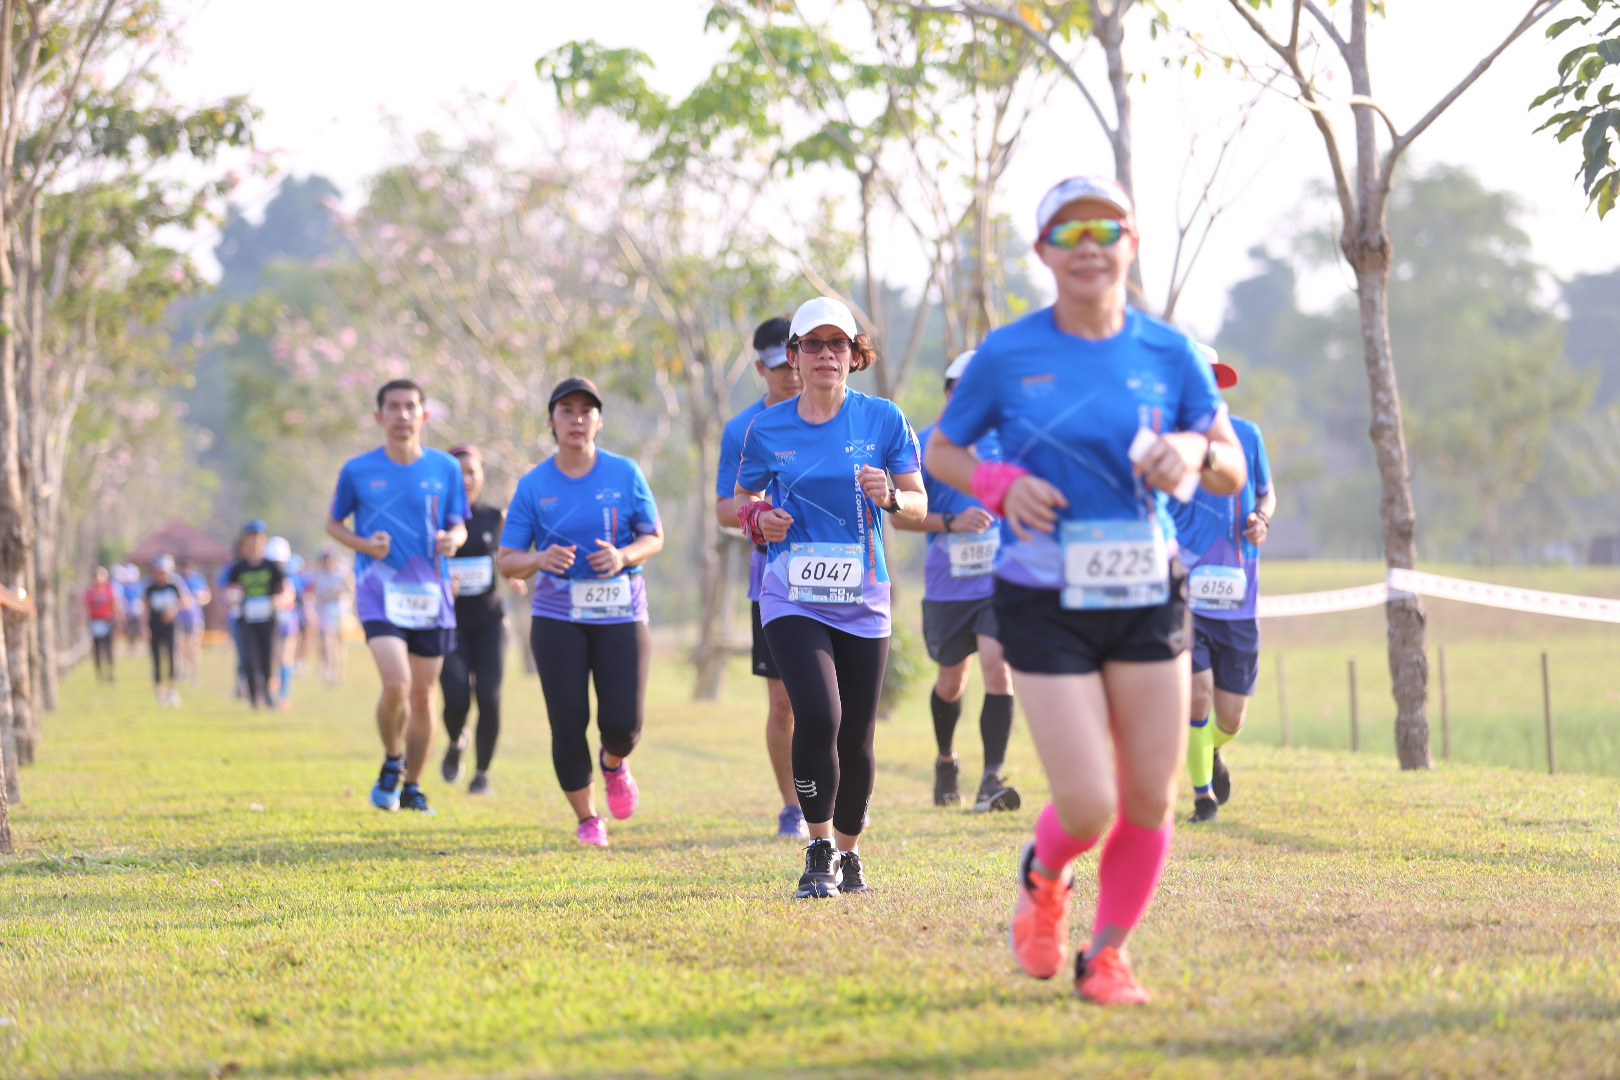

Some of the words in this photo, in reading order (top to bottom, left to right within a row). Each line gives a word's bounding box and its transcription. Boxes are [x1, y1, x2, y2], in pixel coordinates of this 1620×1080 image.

[855, 493, 865, 535] COUNTRY
[867, 528, 876, 567] CHIANG
[801, 561, 852, 581] 6047
[1086, 547, 1155, 577] 6225
[585, 586, 620, 602] 6219
[1201, 580, 1234, 596] 6156
